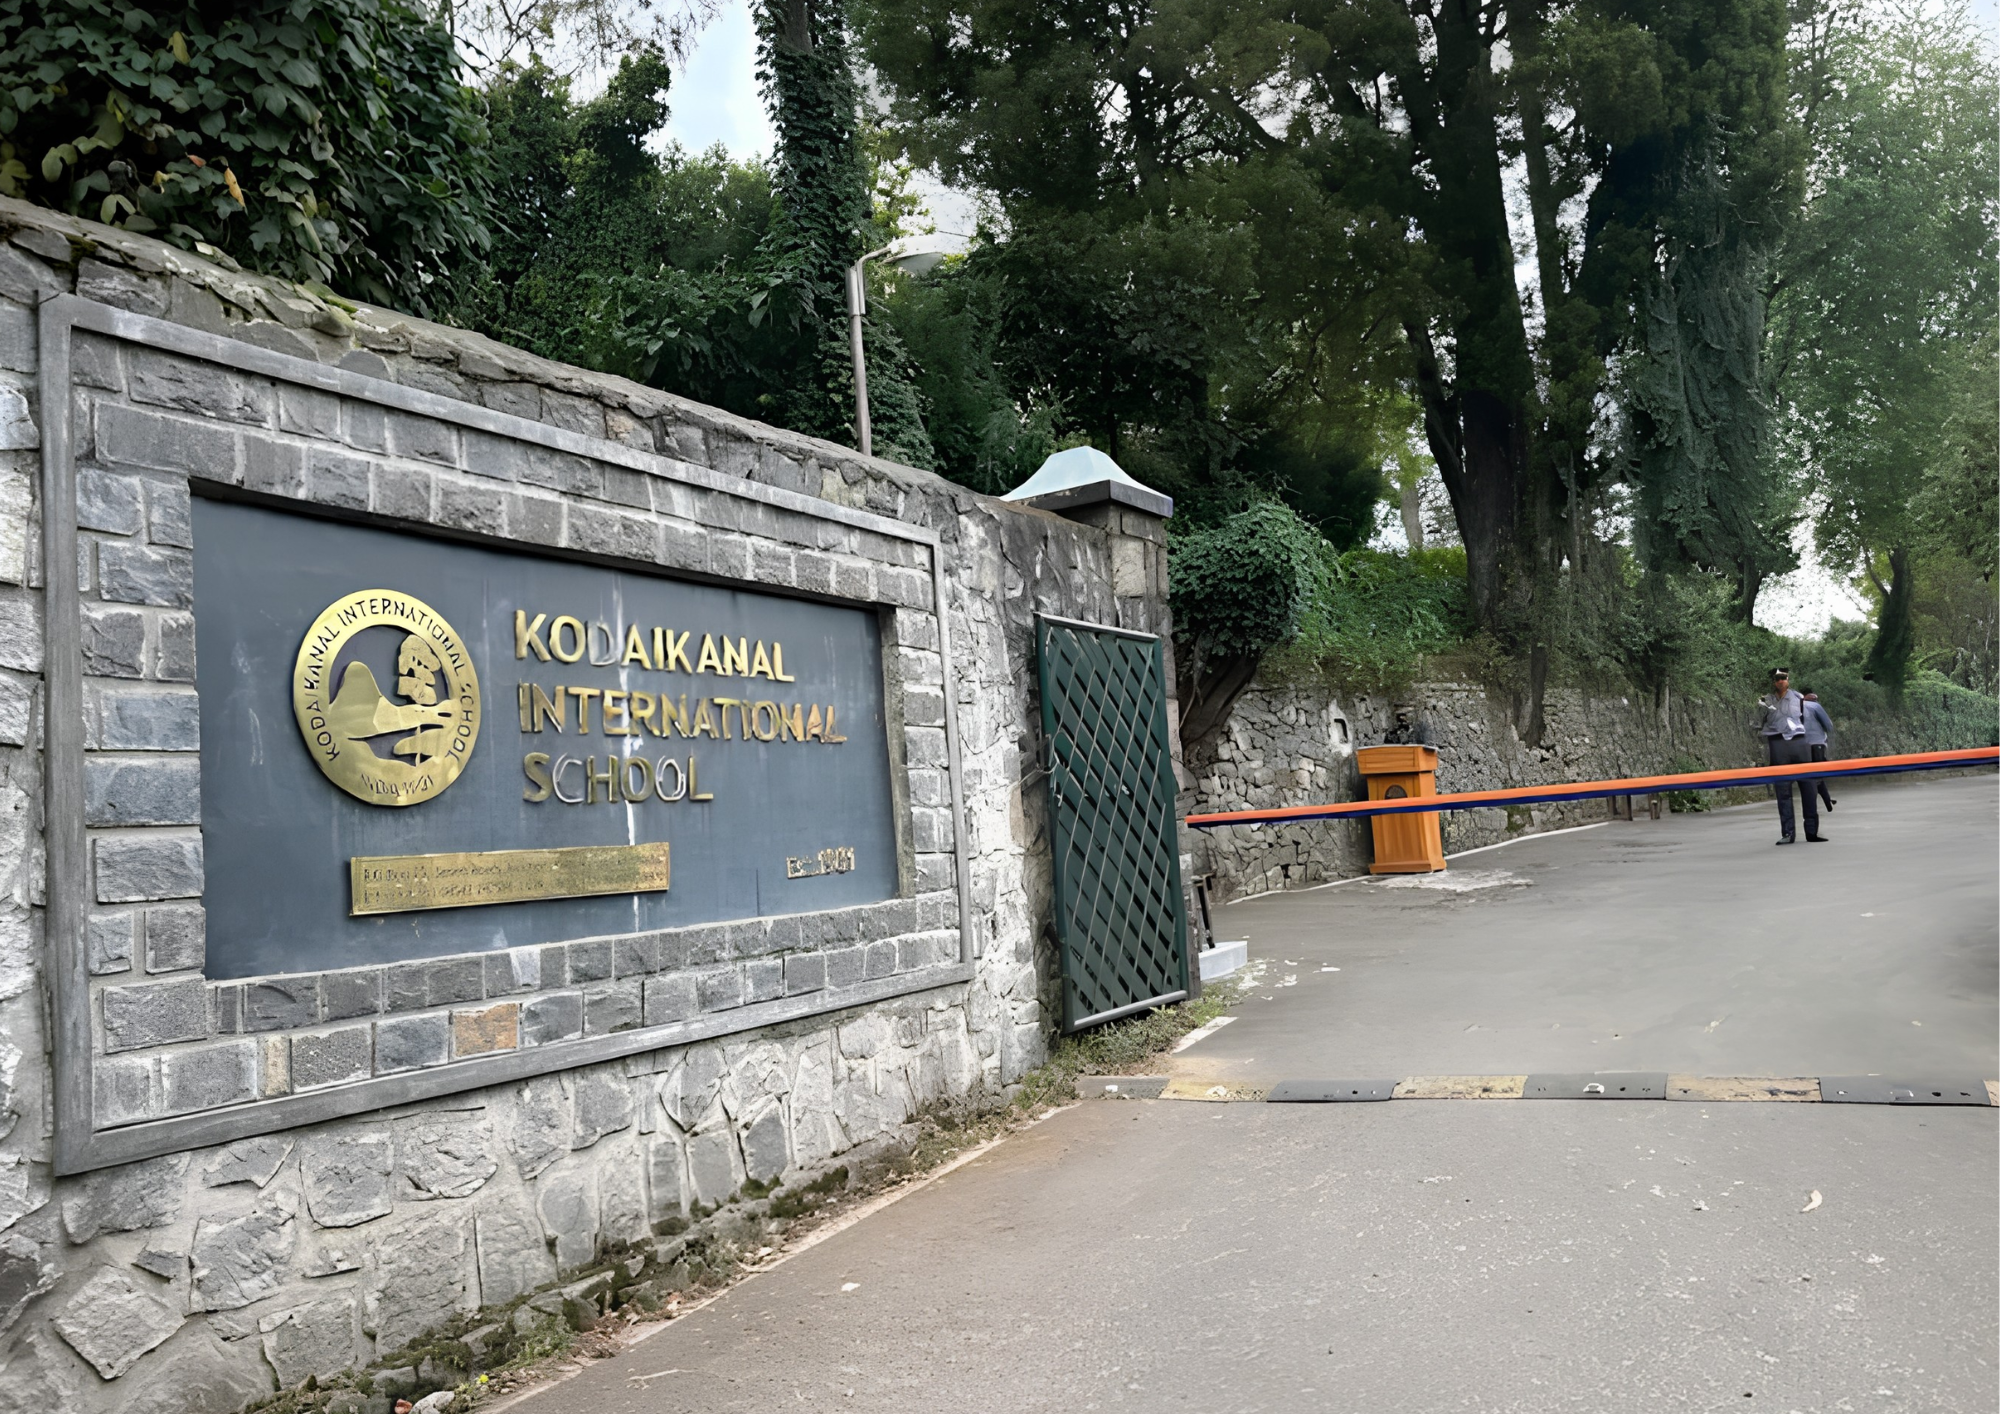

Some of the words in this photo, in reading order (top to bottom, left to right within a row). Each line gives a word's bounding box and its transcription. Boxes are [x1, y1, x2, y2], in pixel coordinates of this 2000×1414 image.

[337, 598, 466, 677] INTERNATIONAL
[515, 609, 795, 682] KODAIKANAL
[518, 682, 848, 744] INTERNATIONAL
[522, 751, 714, 804] SCHOOL
